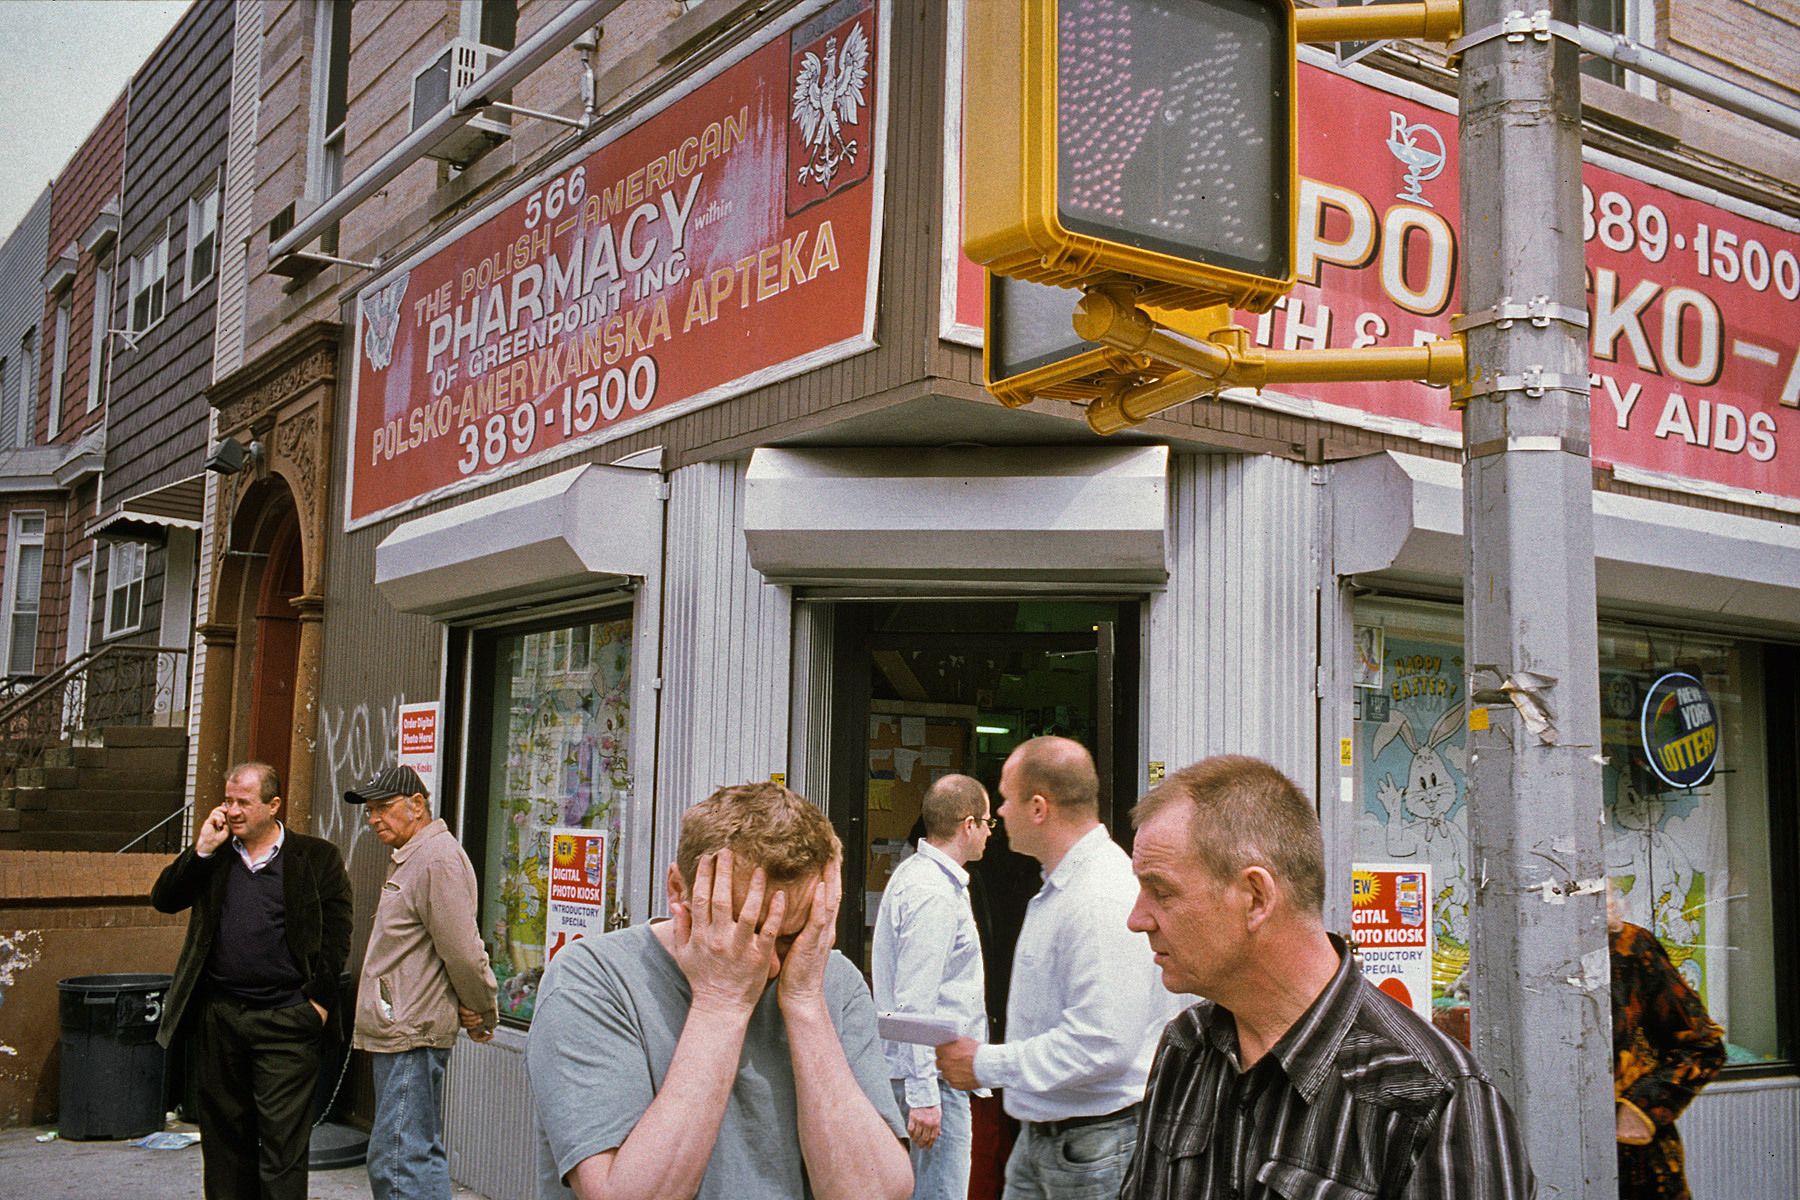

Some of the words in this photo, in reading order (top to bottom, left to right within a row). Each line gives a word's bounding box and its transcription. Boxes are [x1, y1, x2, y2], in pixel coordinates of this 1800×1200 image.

[524, 165, 587, 229] 566
[694, 199, 732, 231] within
[426, 172, 703, 374] PHARMACY
[682, 220, 840, 334] APTEKA
[414, 279, 453, 328] THE
[433, 362, 459, 397] OF
[468, 279, 627, 379] GREENPOINT
[635, 251, 691, 301] INC.
[1655, 392, 1778, 462] AIDS
[1395, 655, 1441, 678] HAPPY
[1676, 686, 1702, 705] NEW
[1681, 702, 1712, 730] YORK
[1658, 723, 1715, 772] LOTTERY
[557, 841, 573, 855] NEW
[553, 867, 580, 881] DIGITAL
[552, 884, 576, 898] PHOTO
[577, 886, 600, 901] KIOSK
[1353, 879, 1372, 895] EW
[552, 903, 599, 917] INTRODUCTORY
[1351, 909, 1389, 924] GITAL
[561, 916, 587, 928] SPECIAL
[1384, 928, 1424, 943] KIOSK
